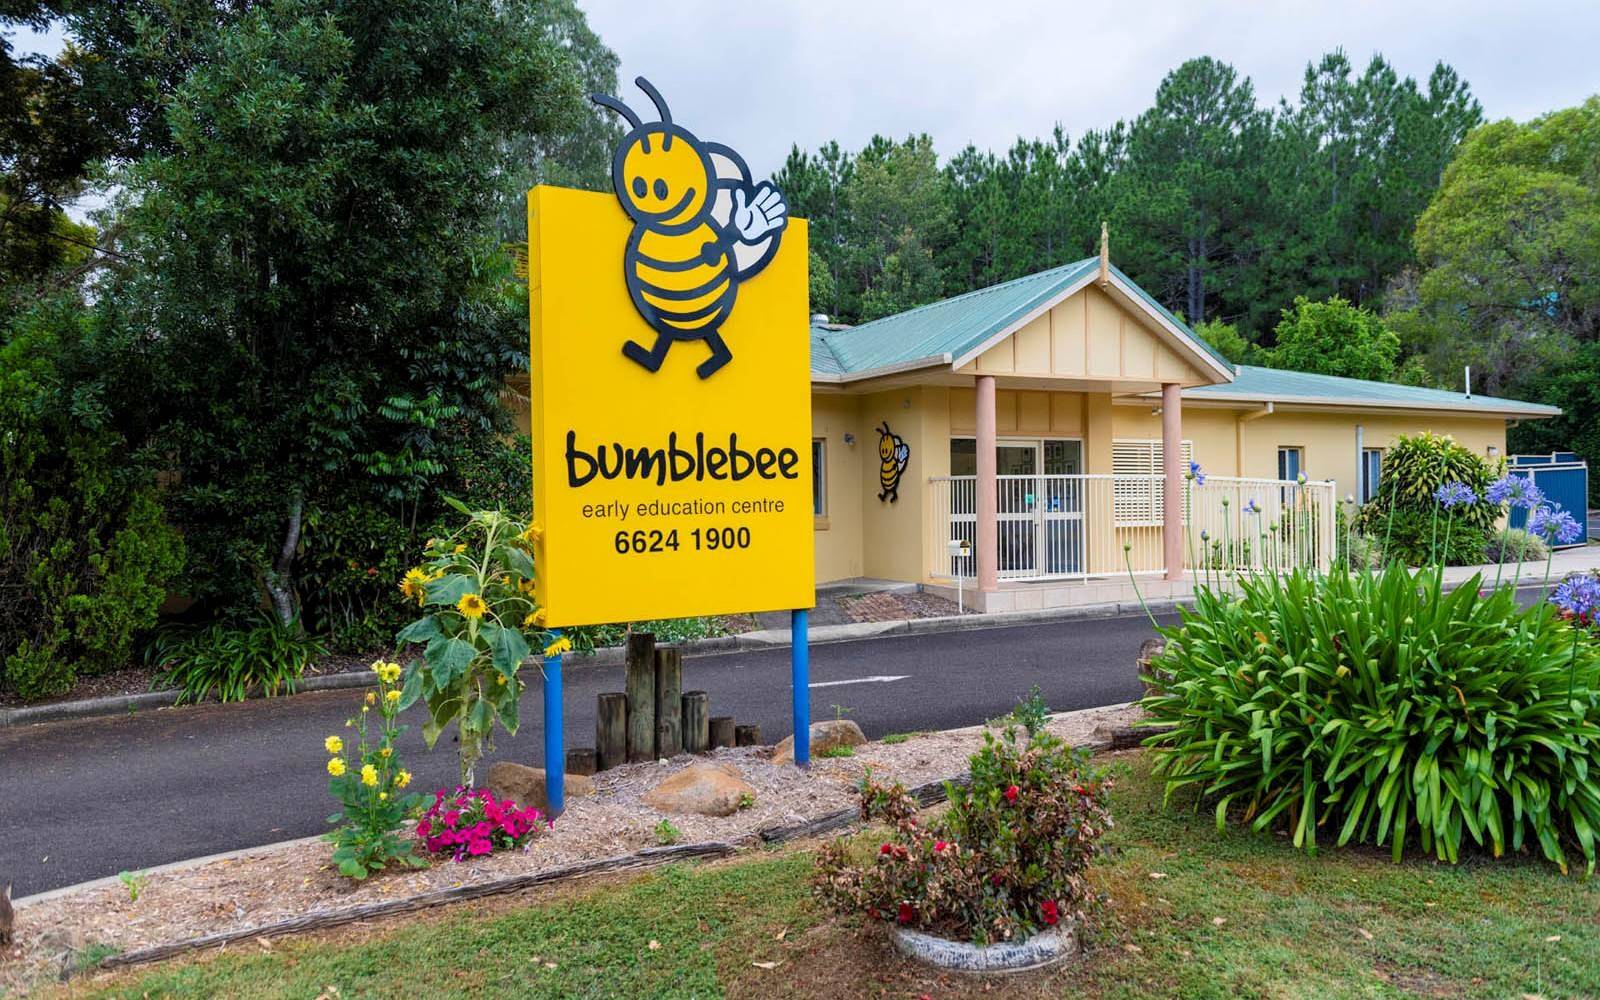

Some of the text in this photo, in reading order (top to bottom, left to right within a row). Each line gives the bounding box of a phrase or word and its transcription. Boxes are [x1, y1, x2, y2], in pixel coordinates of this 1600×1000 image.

[565, 430, 799, 488] bumblebee
[582, 498, 785, 521] early education centre
[615, 526, 751, 554] 6624 1900
